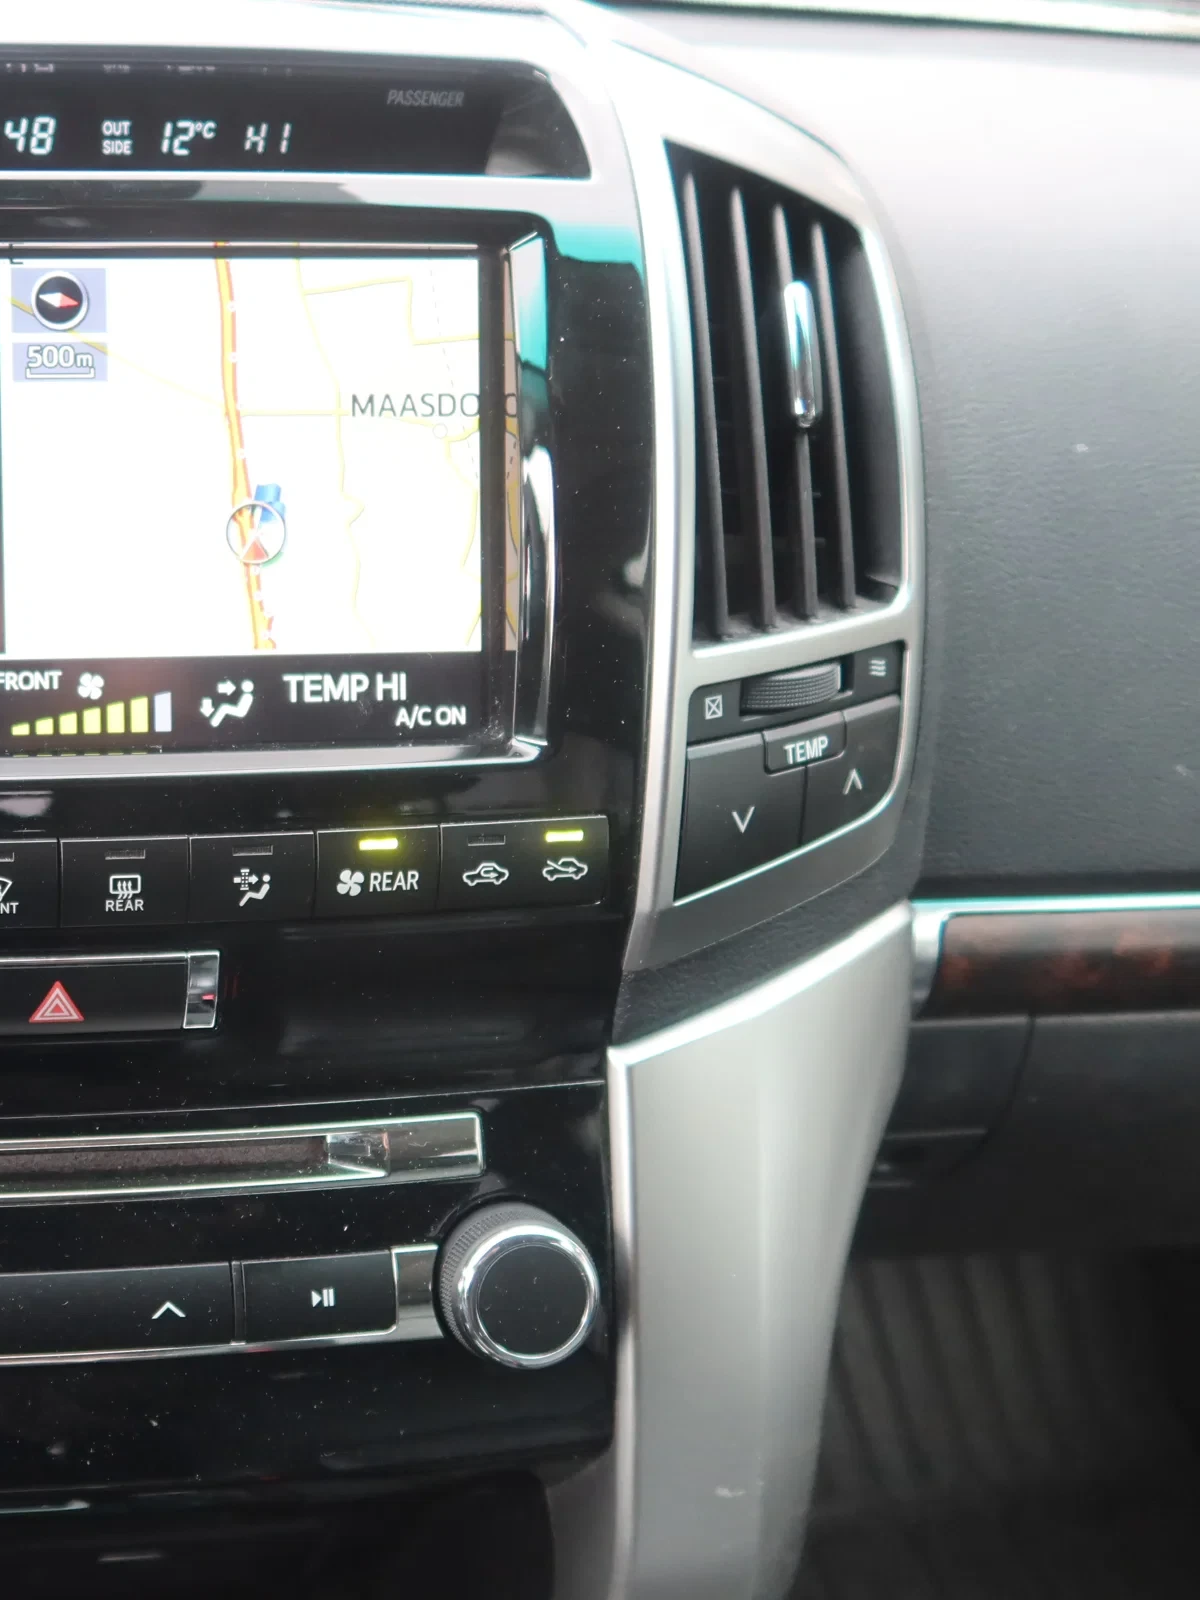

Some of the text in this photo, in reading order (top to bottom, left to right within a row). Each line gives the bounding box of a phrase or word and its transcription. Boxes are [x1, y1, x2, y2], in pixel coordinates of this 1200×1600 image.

[387, 89, 465, 107] PASSENGER
[102, 121, 131, 137] OUT
[102, 140, 132, 155] SIDE
[26, 345, 94, 369] 500m
[283, 672, 407, 704] TEMP HI
[395, 705, 467, 727] A/C ON
[783, 735, 829, 765] TEMP
[368, 871, 419, 893] REAR
[105, 900, 144, 912] REAR
